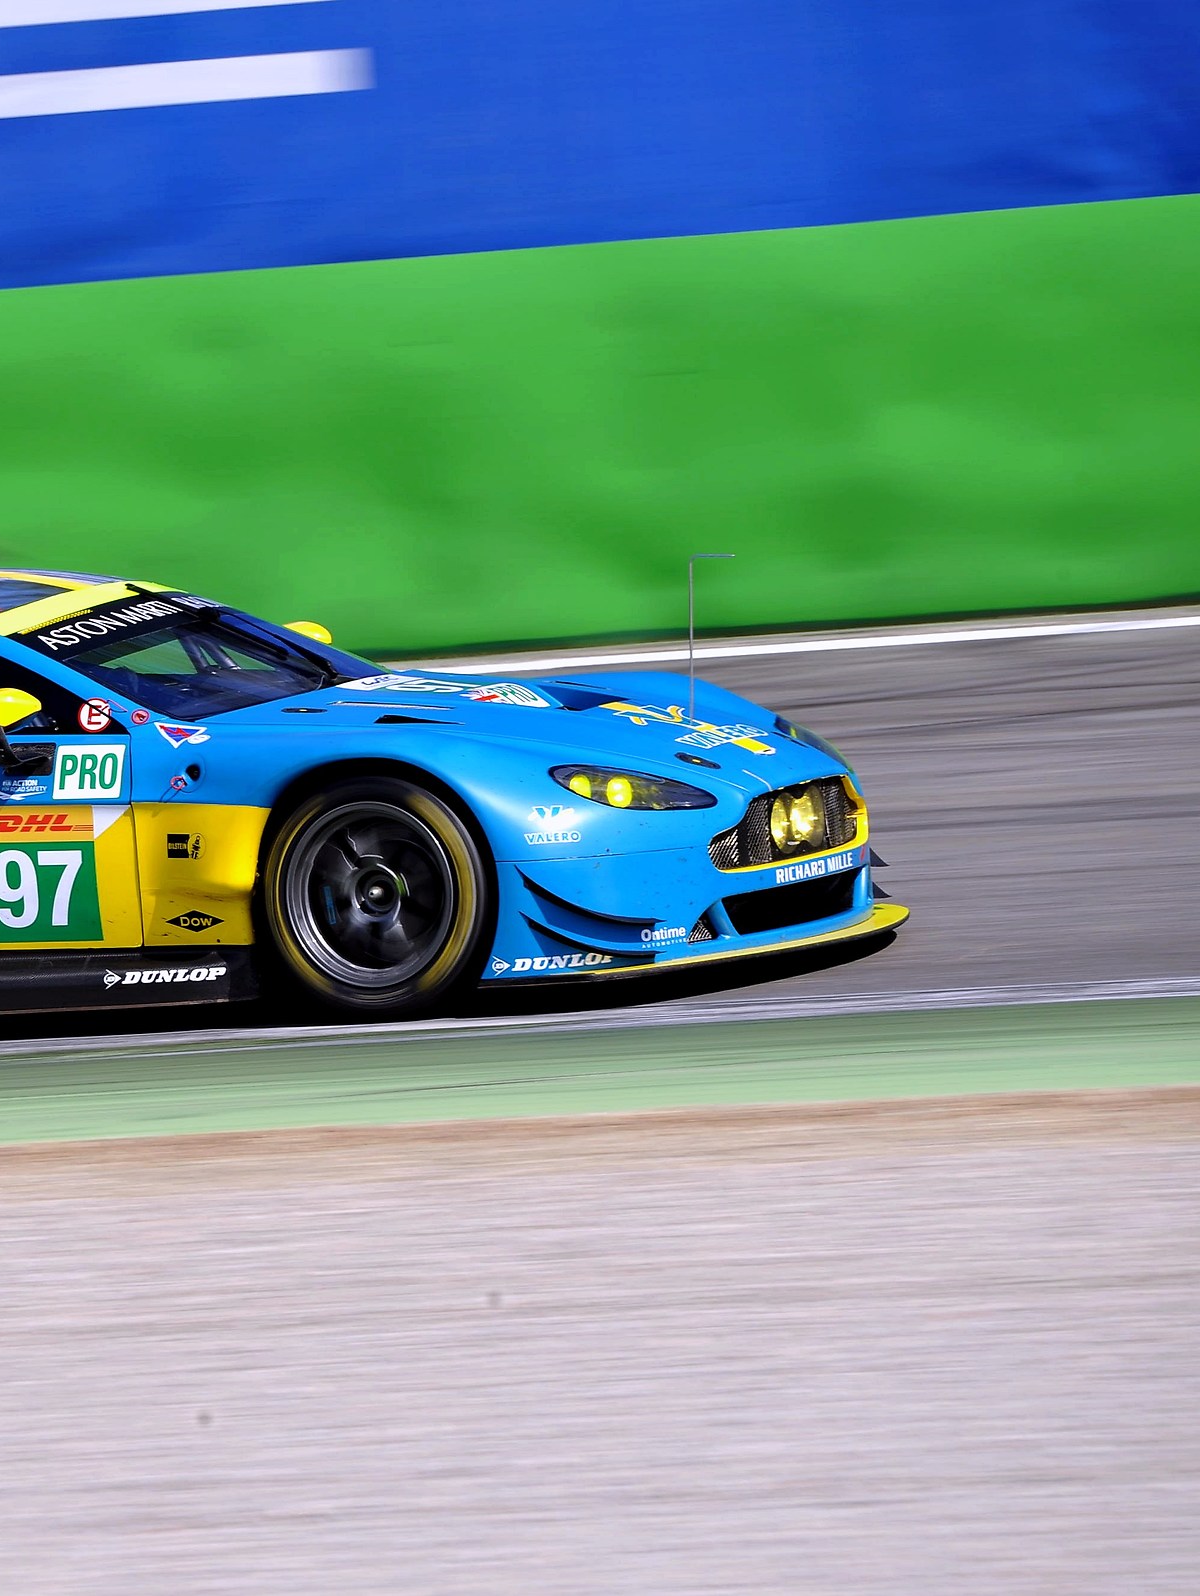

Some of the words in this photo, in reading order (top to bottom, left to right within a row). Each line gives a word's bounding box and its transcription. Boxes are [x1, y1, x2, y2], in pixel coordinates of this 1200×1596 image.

[37, 611, 128, 651] ASTON
[116, 599, 184, 625] MARTI
[674, 724, 769, 749] VALERO
[58, 753, 119, 790] PRO
[12, 779, 38, 787] ACTION
[524, 831, 581, 844] VALERO
[775, 859, 826, 884] RICHARD
[827, 852, 853, 873] MILLE
[641, 926, 686, 942] Ontime
[121, 966, 227, 985] DUNLOP
